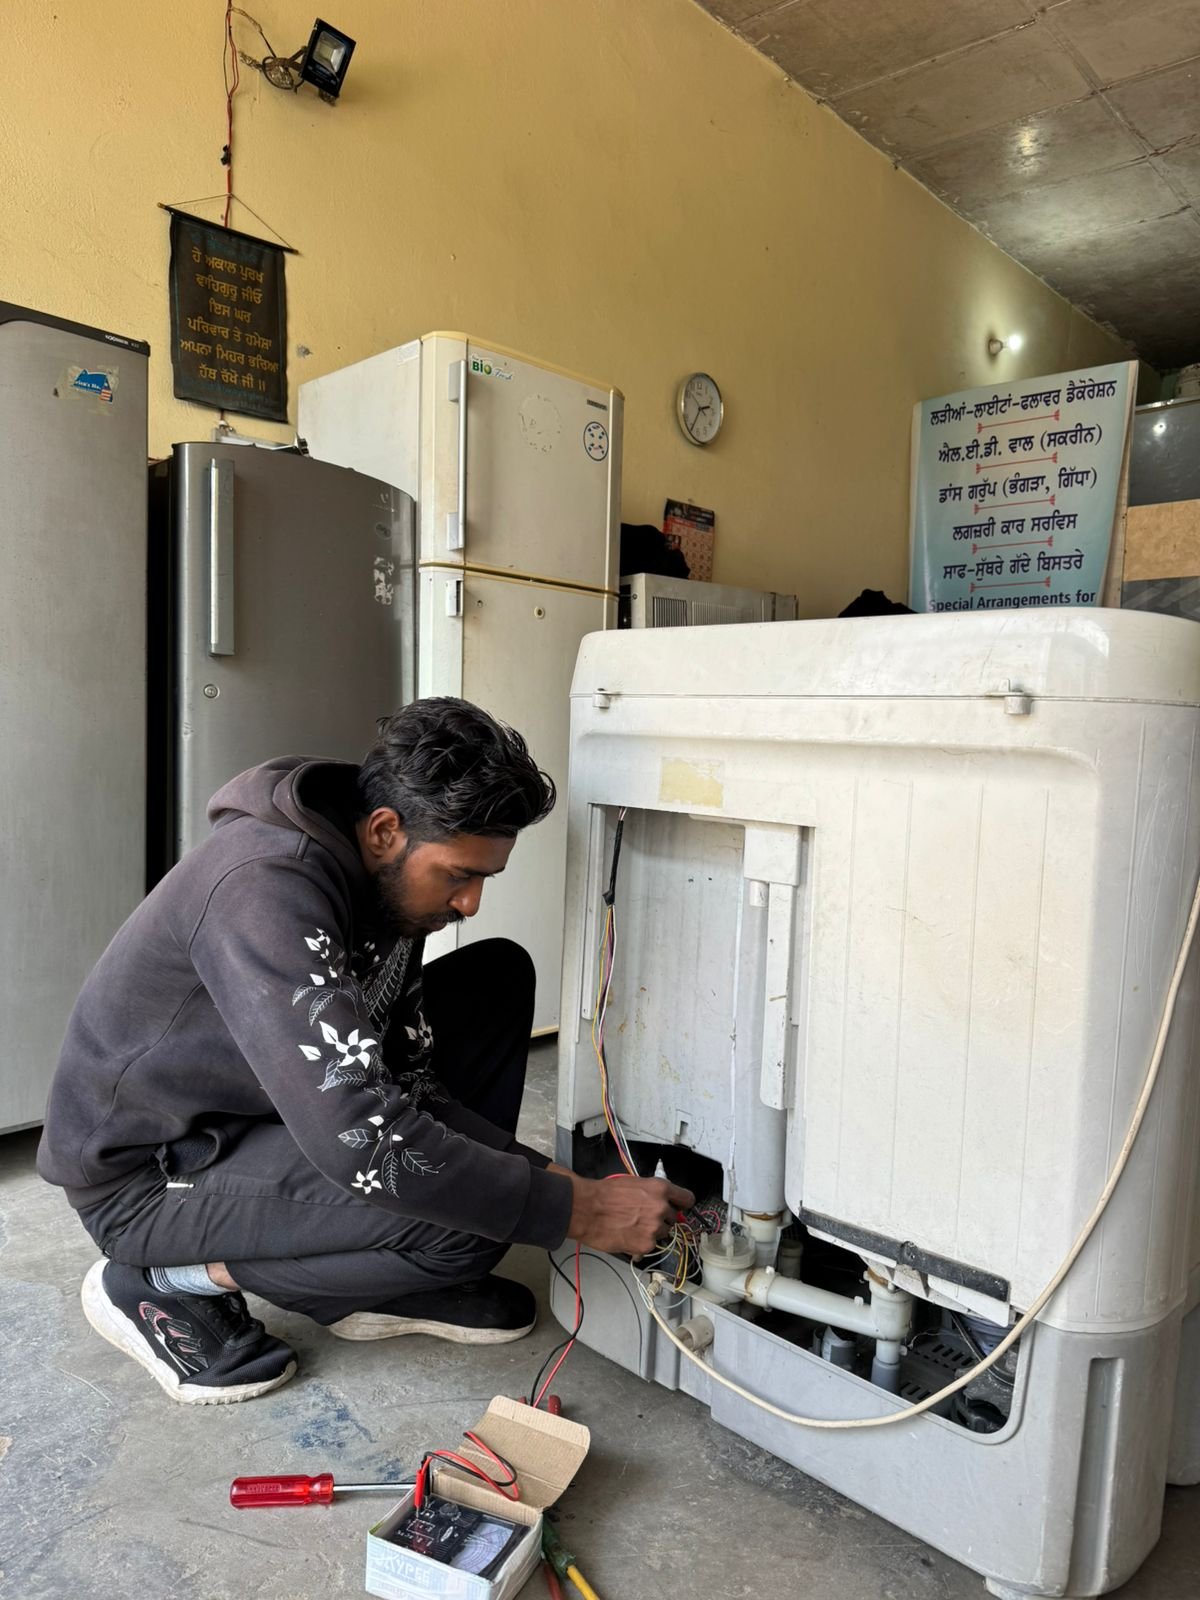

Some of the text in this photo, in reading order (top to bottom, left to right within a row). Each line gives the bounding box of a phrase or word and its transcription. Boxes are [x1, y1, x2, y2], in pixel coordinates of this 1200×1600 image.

[205, 256, 237, 275] ਅਕਾਲ
[240, 265, 265, 284] ਪੁਰਖ
[209, 298, 252, 324] ਇਸ ਘਰ
[187, 315, 229, 339] ਪਰਿਵਾਰ
[232, 326, 243, 343] ਤੇ
[216, 343, 245, 365] ਮਿਹਰ
[241, 372, 255, 390] ਜੀ
[1008, 435, 1035, 454] ਵਾਲ
[1040, 423, 1103, 452] (ਸਕਰੀਨ)
[939, 466, 1098, 503] ਡਾਂਸ ਗਰੁੱਪ (ਭੰਗੜਾ, ਗਿੱਧਾ)
[952, 509, 1078, 541] ਲਗਜ਼ਰੀ ਕਾਰ ਸਰਵਿਸ
[943, 548, 1084, 581] ਸਾਫ-ਸੁੱਥਰੇ ਗੱਦੇ ਬਿਸਤਰੇ
[928, 589, 1096, 613] Special Arrangements for
